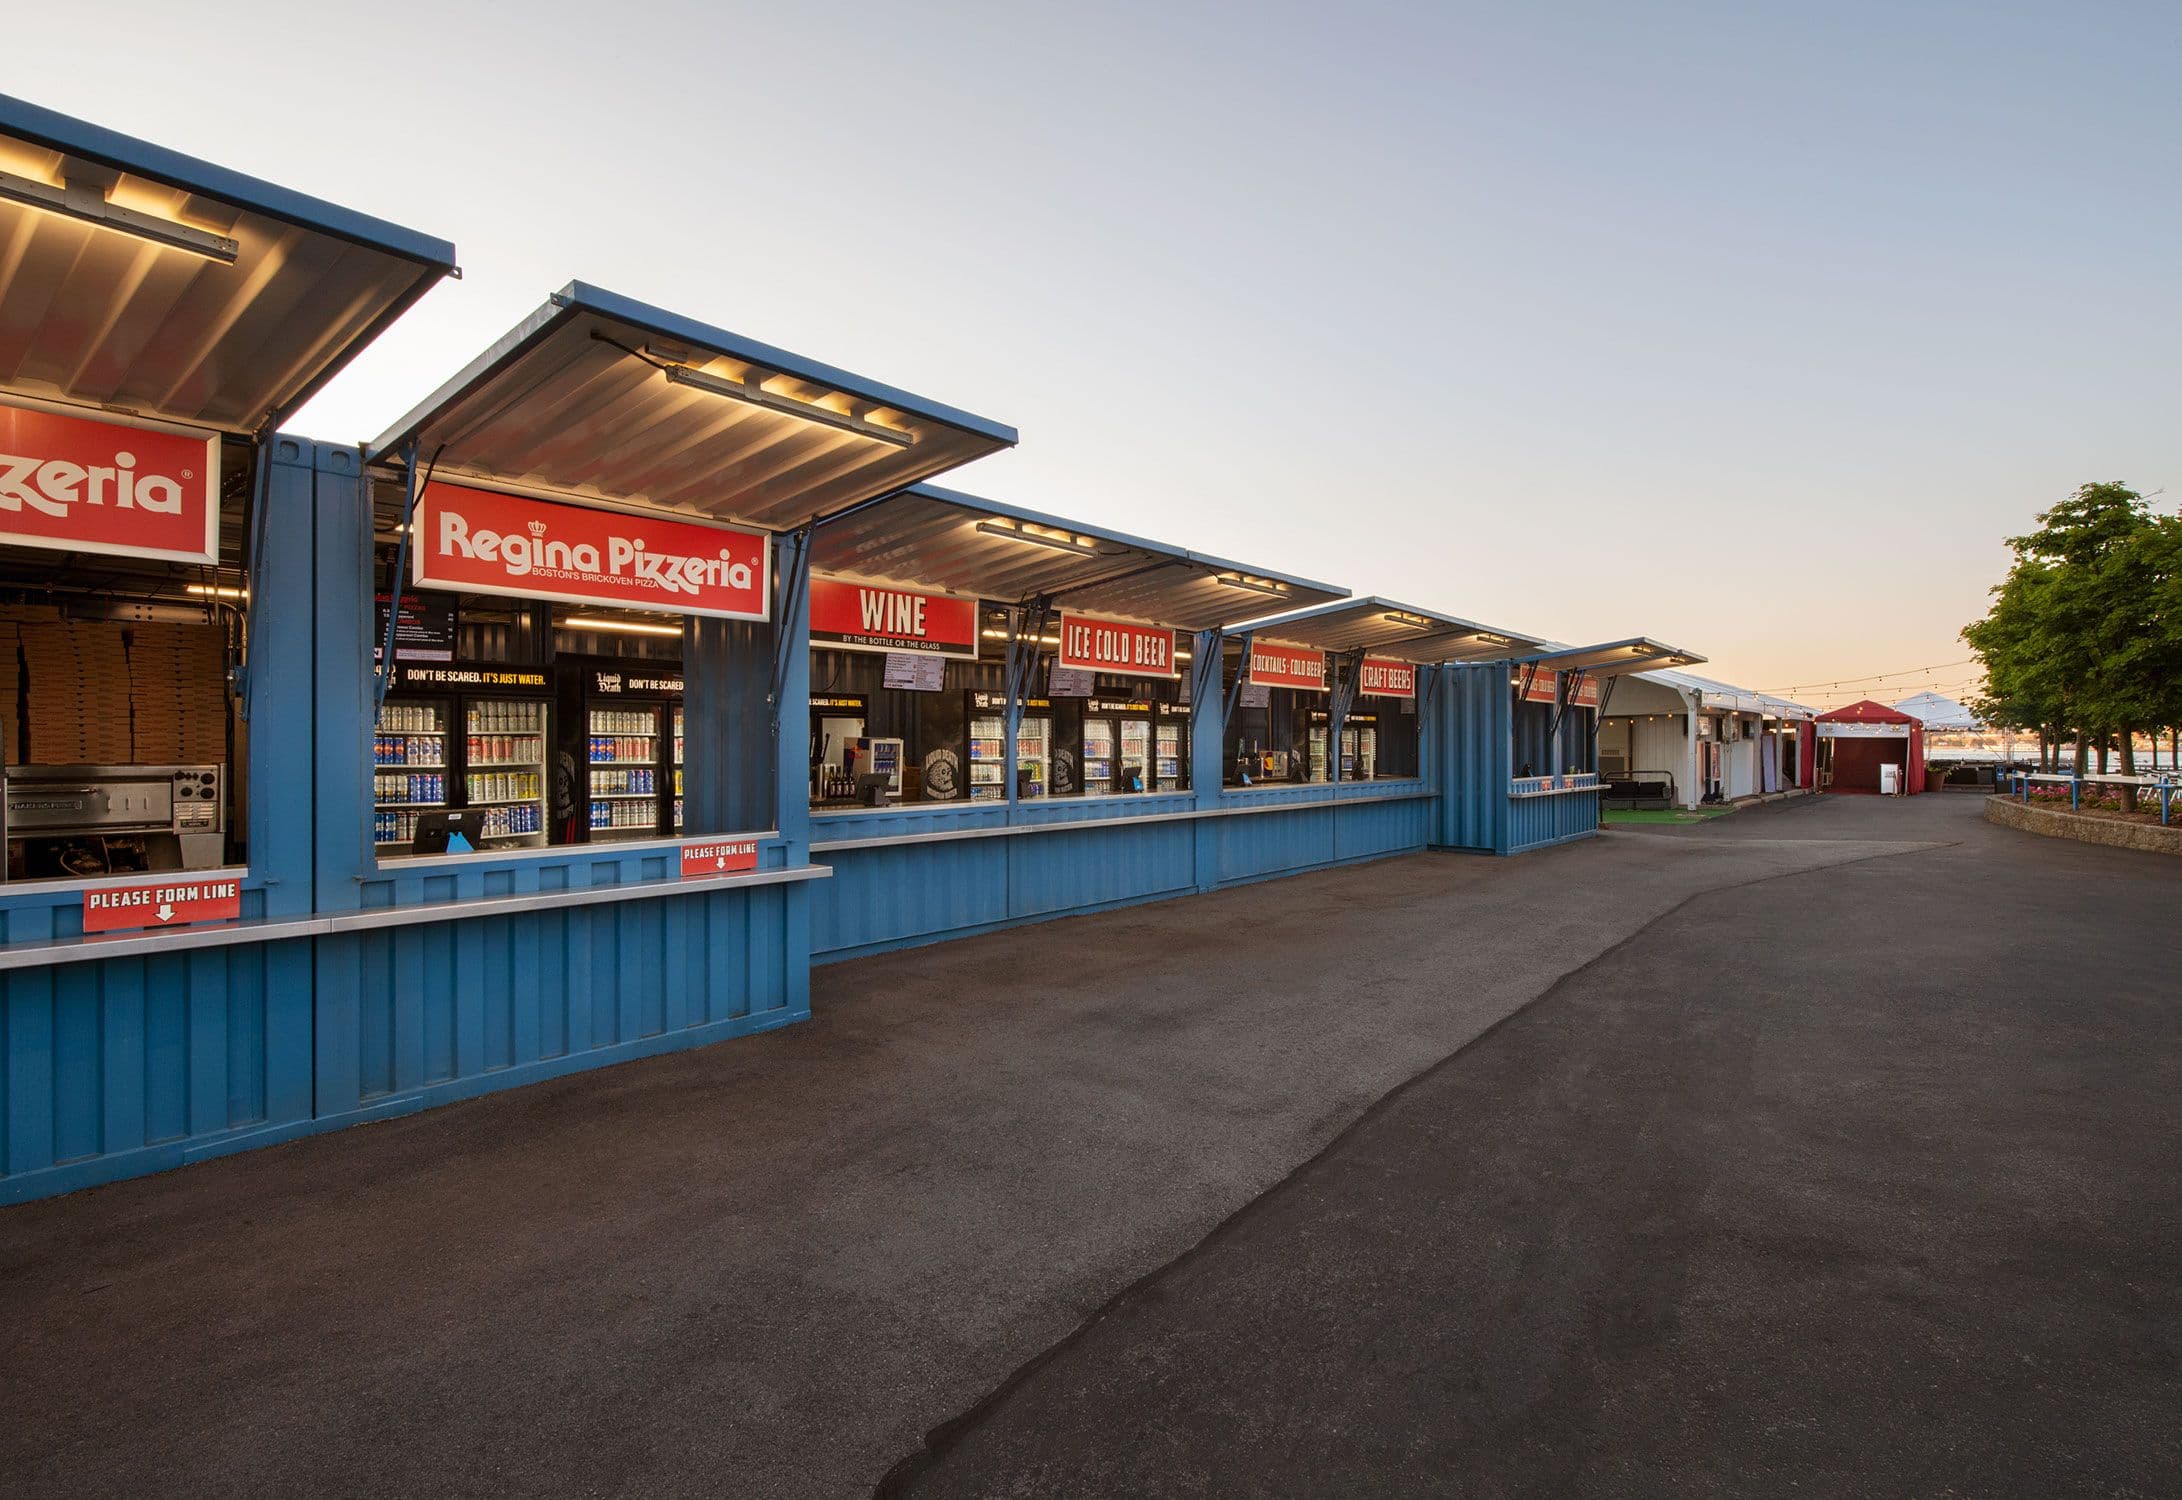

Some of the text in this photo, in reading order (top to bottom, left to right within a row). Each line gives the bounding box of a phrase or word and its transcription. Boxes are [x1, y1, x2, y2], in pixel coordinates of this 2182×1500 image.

[0, 451, 183, 518] zeria
[438, 511, 752, 595] Regina Pizzeria
[532, 567, 660, 588] BOSTON'S BRICKOVEN PIZZA
[859, 589, 927, 636] WINE
[842, 634, 941, 650] BY THE BOTTLE OR THE GLASS
[1068, 624, 1166, 667] ICE COLD BEER
[407, 668, 435, 681] DON'T
[435, 670, 446, 682] BE
[447, 671, 482, 683] SCARED.
[483, 672, 498, 684] IT'S
[499, 672, 518, 685] JUST
[518, 674, 546, 686] WATER.
[1252, 654, 1322, 678] COCKTAILS COLD BEER
[1364, 666, 1411, 690] CRAFT BEERS
[629, 678, 650, 689] DON'T
[650, 680, 659, 690] BE
[684, 843, 756, 860] PLEASE FORM LINE
[89, 883, 236, 909] PLEASE FORM LINE
